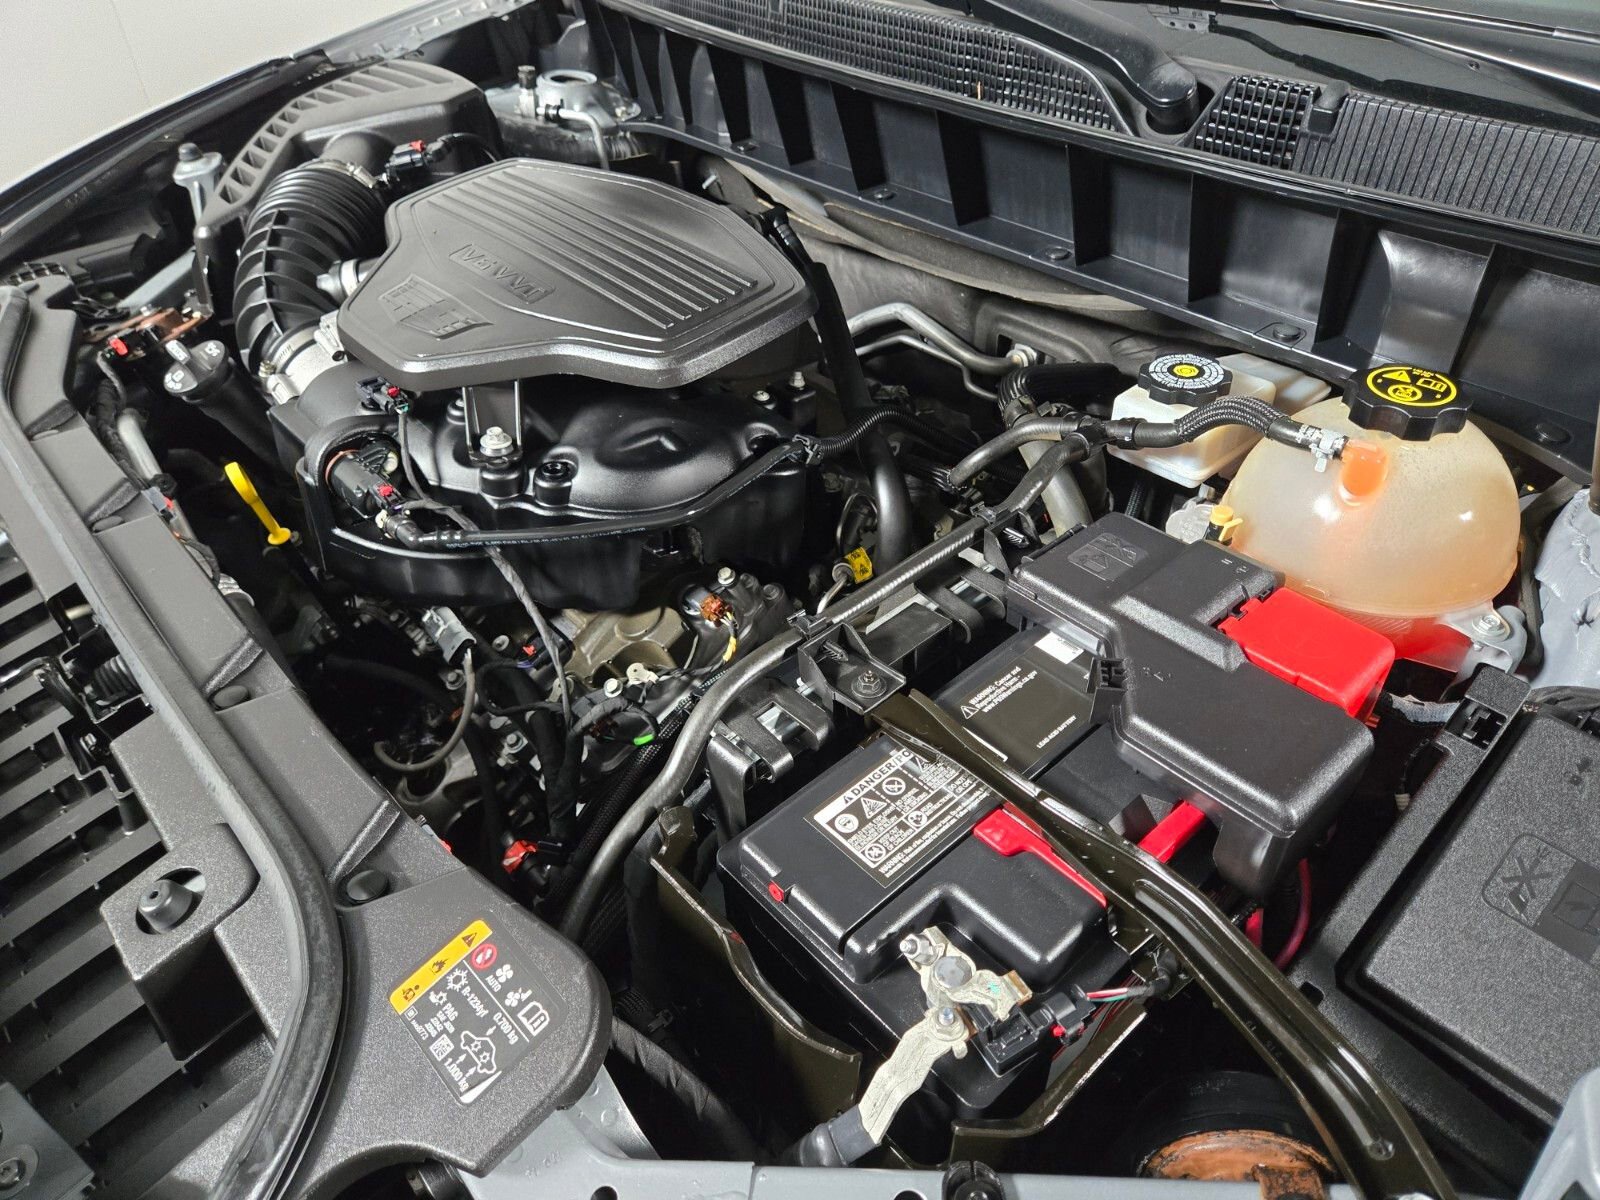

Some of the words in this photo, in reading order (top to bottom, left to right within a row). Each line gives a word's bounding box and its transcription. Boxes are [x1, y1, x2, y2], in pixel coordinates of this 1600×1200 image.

[494, 266, 545, 298] VVT
[968, 684, 997, 705] WARNING:
[1057, 715, 1077, 732] BATTERY
[485, 974, 502, 992] AUTO
[443, 1003, 460, 1022] PAG
[461, 986, 489, 1019] R-1234yf
[492, 1012, 513, 1034] 0.700
[505, 1030, 520, 1045] kg
[442, 1057, 463, 1081] 1.000
[456, 1078, 471, 1092] kg
